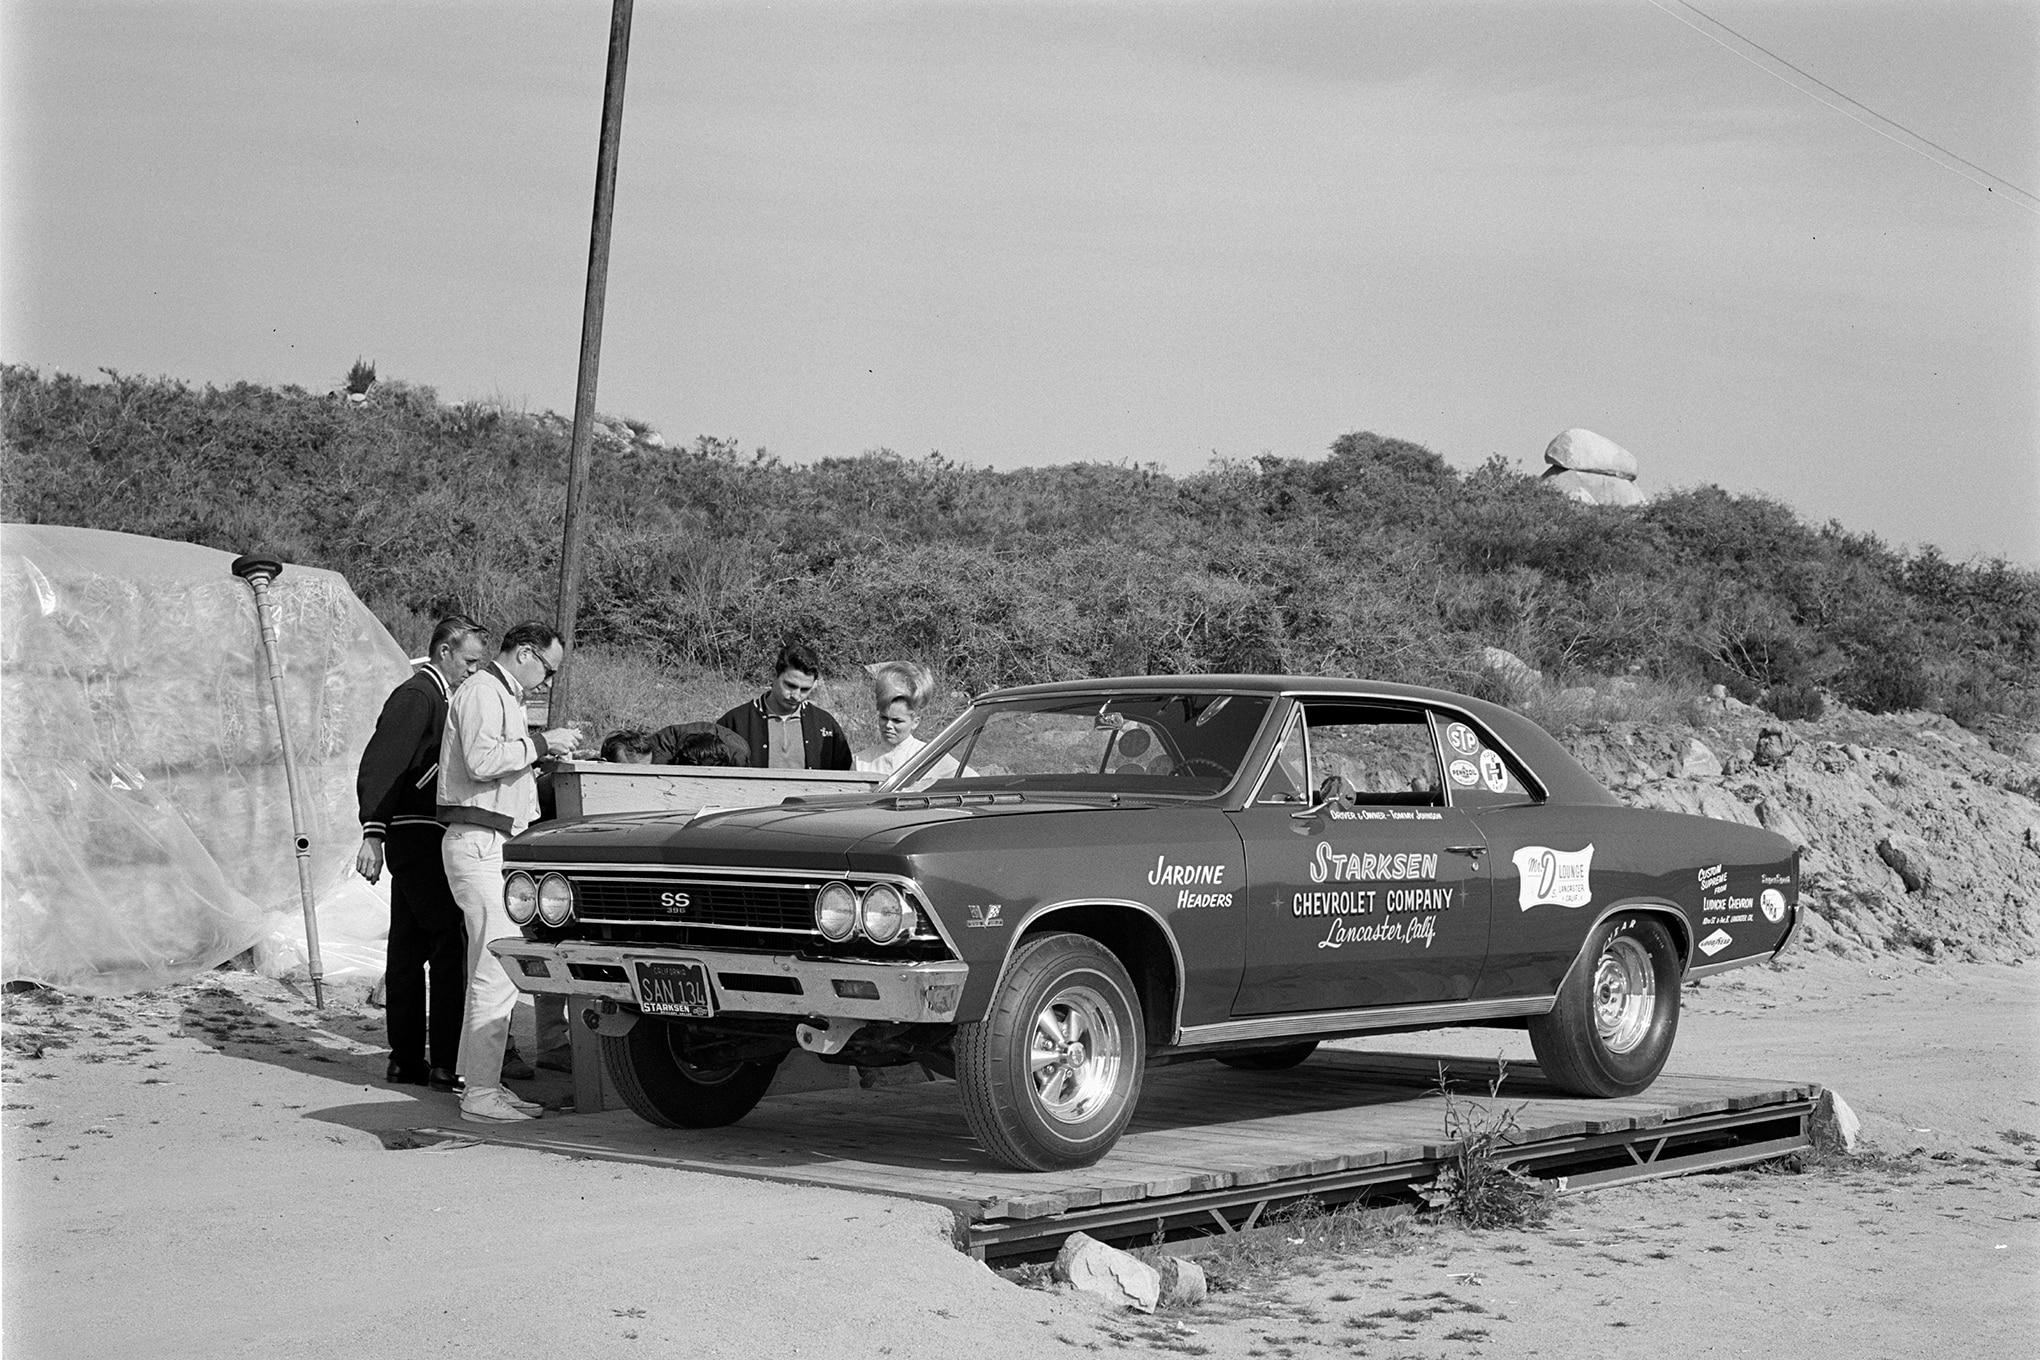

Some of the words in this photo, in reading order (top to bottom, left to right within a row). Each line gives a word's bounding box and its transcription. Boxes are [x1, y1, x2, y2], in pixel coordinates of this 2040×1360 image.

[1451, 726, 1476, 751] STP
[1147, 855, 1225, 886] JARDINE
[1310, 841, 1438, 883] STARKSEN
[1559, 863, 1585, 879] LOUNGE
[1697, 863, 1722, 882] CUSTOM
[1700, 871, 1728, 891] SUPREME
[661, 892, 690, 907] SS
[1177, 889, 1233, 909] HEADERS
[1293, 891, 1376, 916] CHEVROLET
[1386, 888, 1453, 912] COMPANY
[1728, 895, 1754, 910] CHEVRON
[642, 978, 675, 1004] SAN
[643, 1002, 690, 1014] STARKSEN
